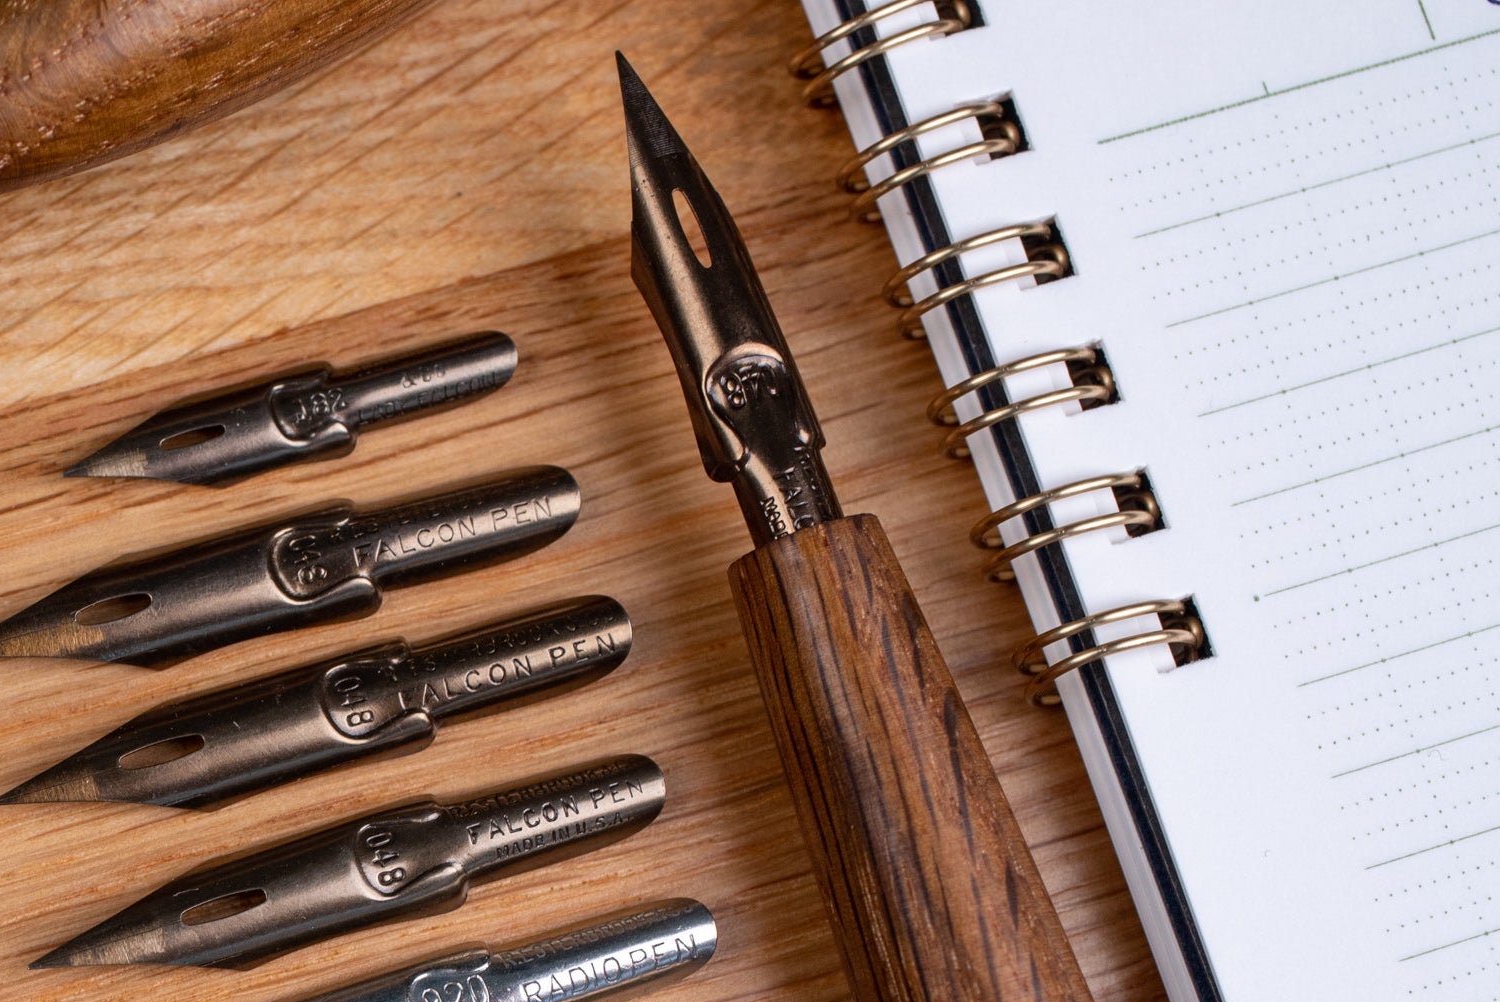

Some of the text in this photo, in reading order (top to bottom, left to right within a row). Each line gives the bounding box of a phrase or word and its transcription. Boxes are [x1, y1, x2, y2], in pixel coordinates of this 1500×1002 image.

[352, 515, 477, 568] FALCON
[489, 495, 554, 533] PEN
[548, 632, 618, 671] PEN
[465, 777, 645, 847] FALCON PEN
[365, 830, 407, 887] 048
[495, 832, 546, 861] MADE
[552, 826, 571, 844] IN
[628, 933, 700, 979] PEN
